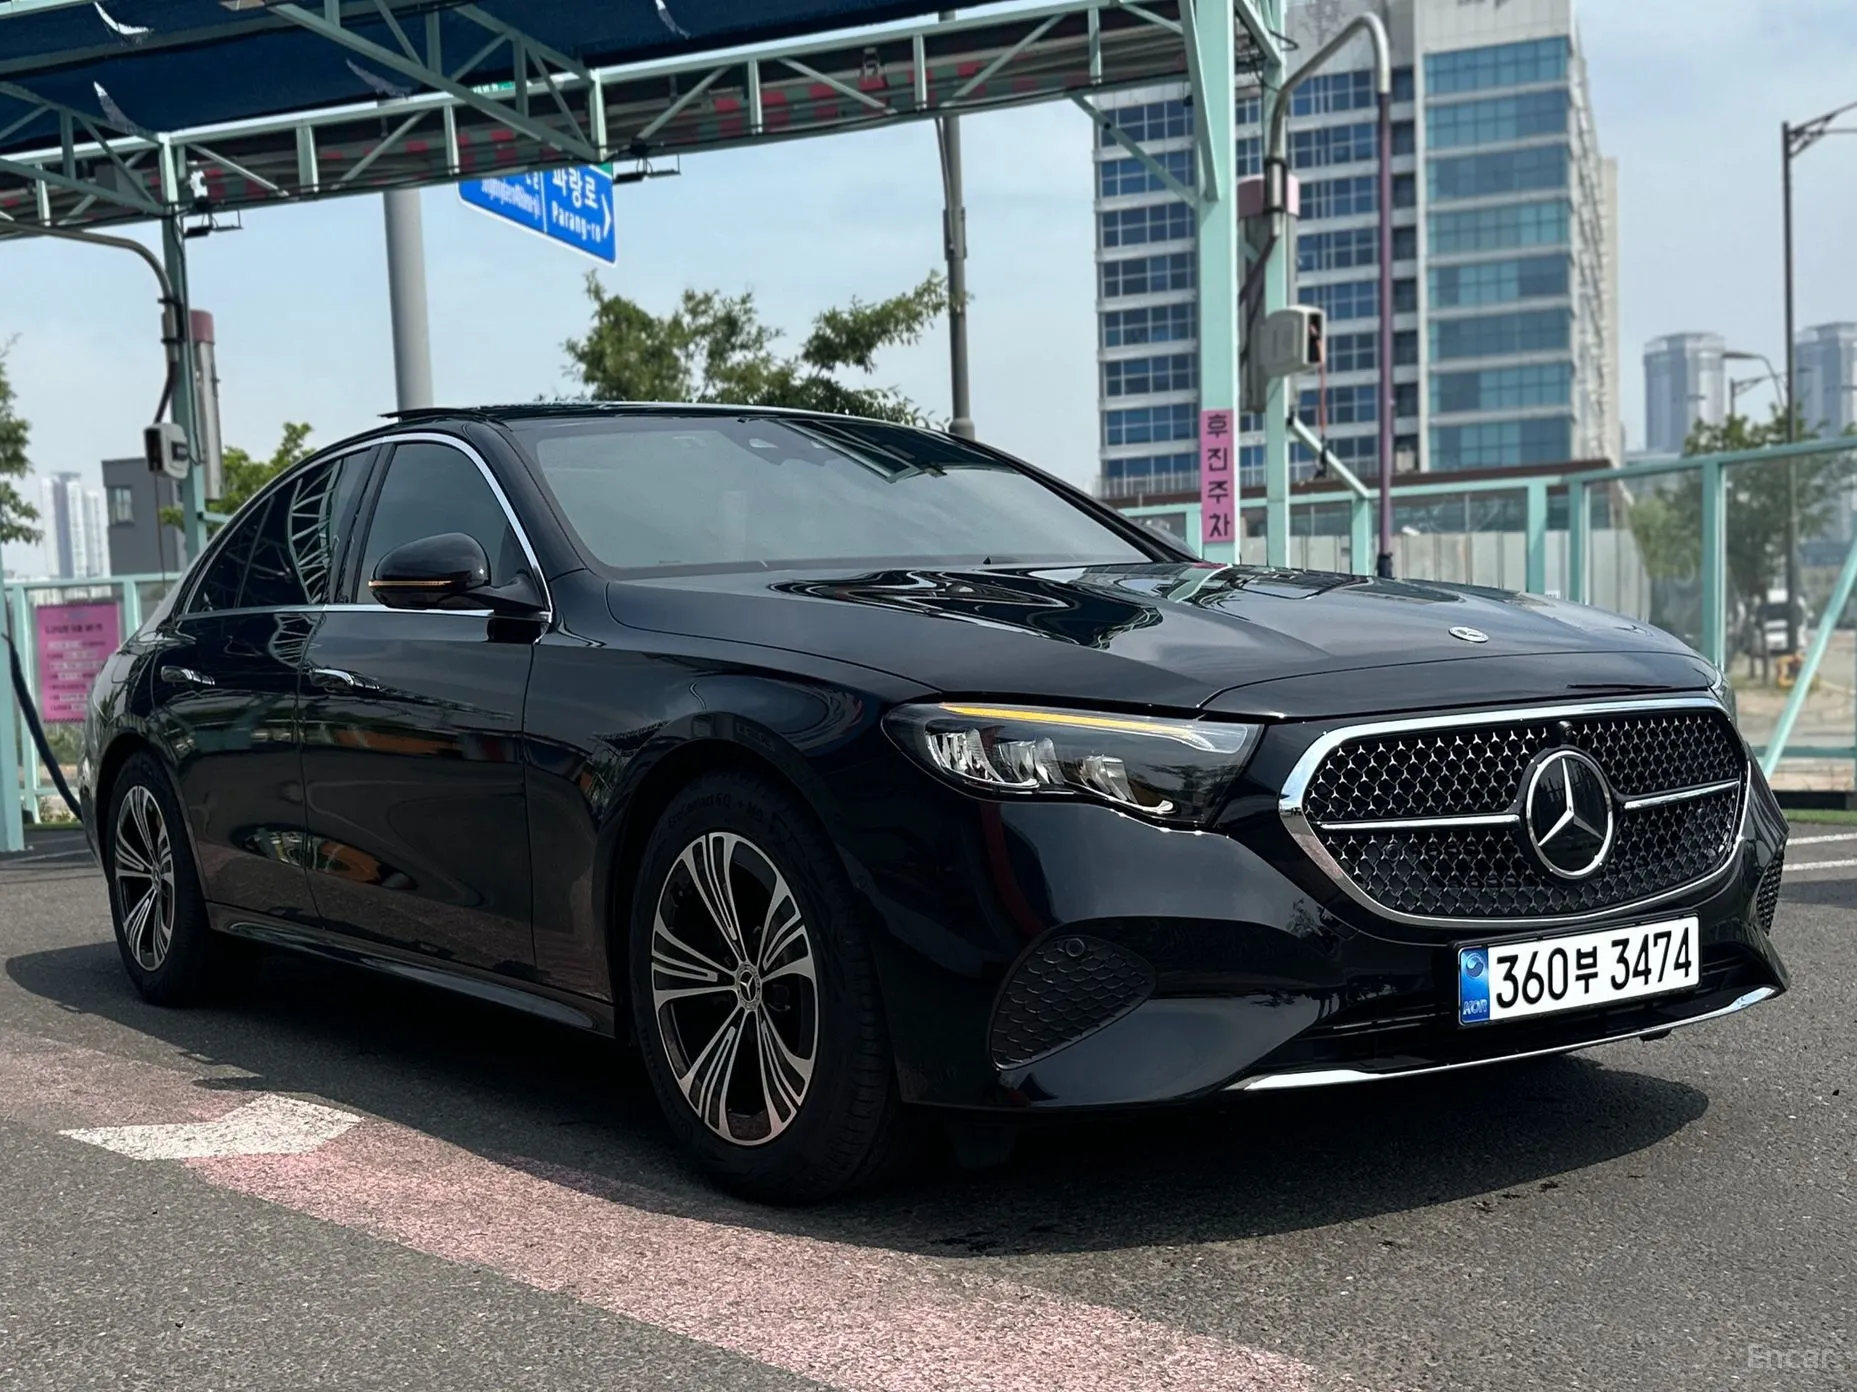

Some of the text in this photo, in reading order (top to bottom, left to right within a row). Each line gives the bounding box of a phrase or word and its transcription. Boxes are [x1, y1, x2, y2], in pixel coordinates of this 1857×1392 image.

[552, 168, 598, 209] 파랑로
[552, 200, 601, 243] Parang-ro
[1207, 414, 1230, 537] 후진주차
[1496, 927, 1691, 1009] 360부 3474
